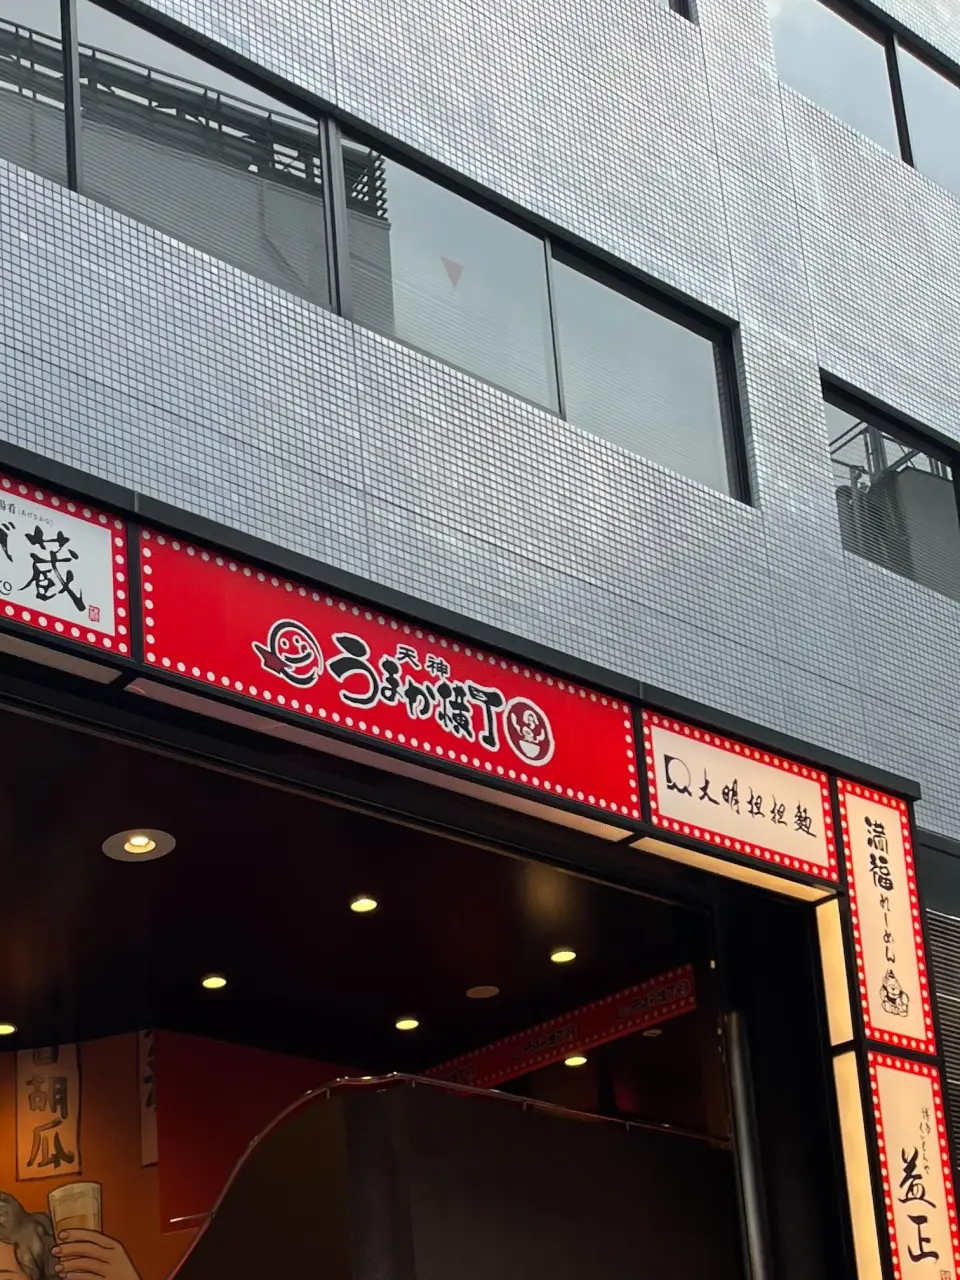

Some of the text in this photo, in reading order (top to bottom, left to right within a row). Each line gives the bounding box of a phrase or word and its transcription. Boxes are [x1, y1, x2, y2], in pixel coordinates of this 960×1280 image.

[327, 633, 505, 752] うまか横丁
[397, 643, 450, 678] 天神
[898, 1146, 940, 1263] 益正
